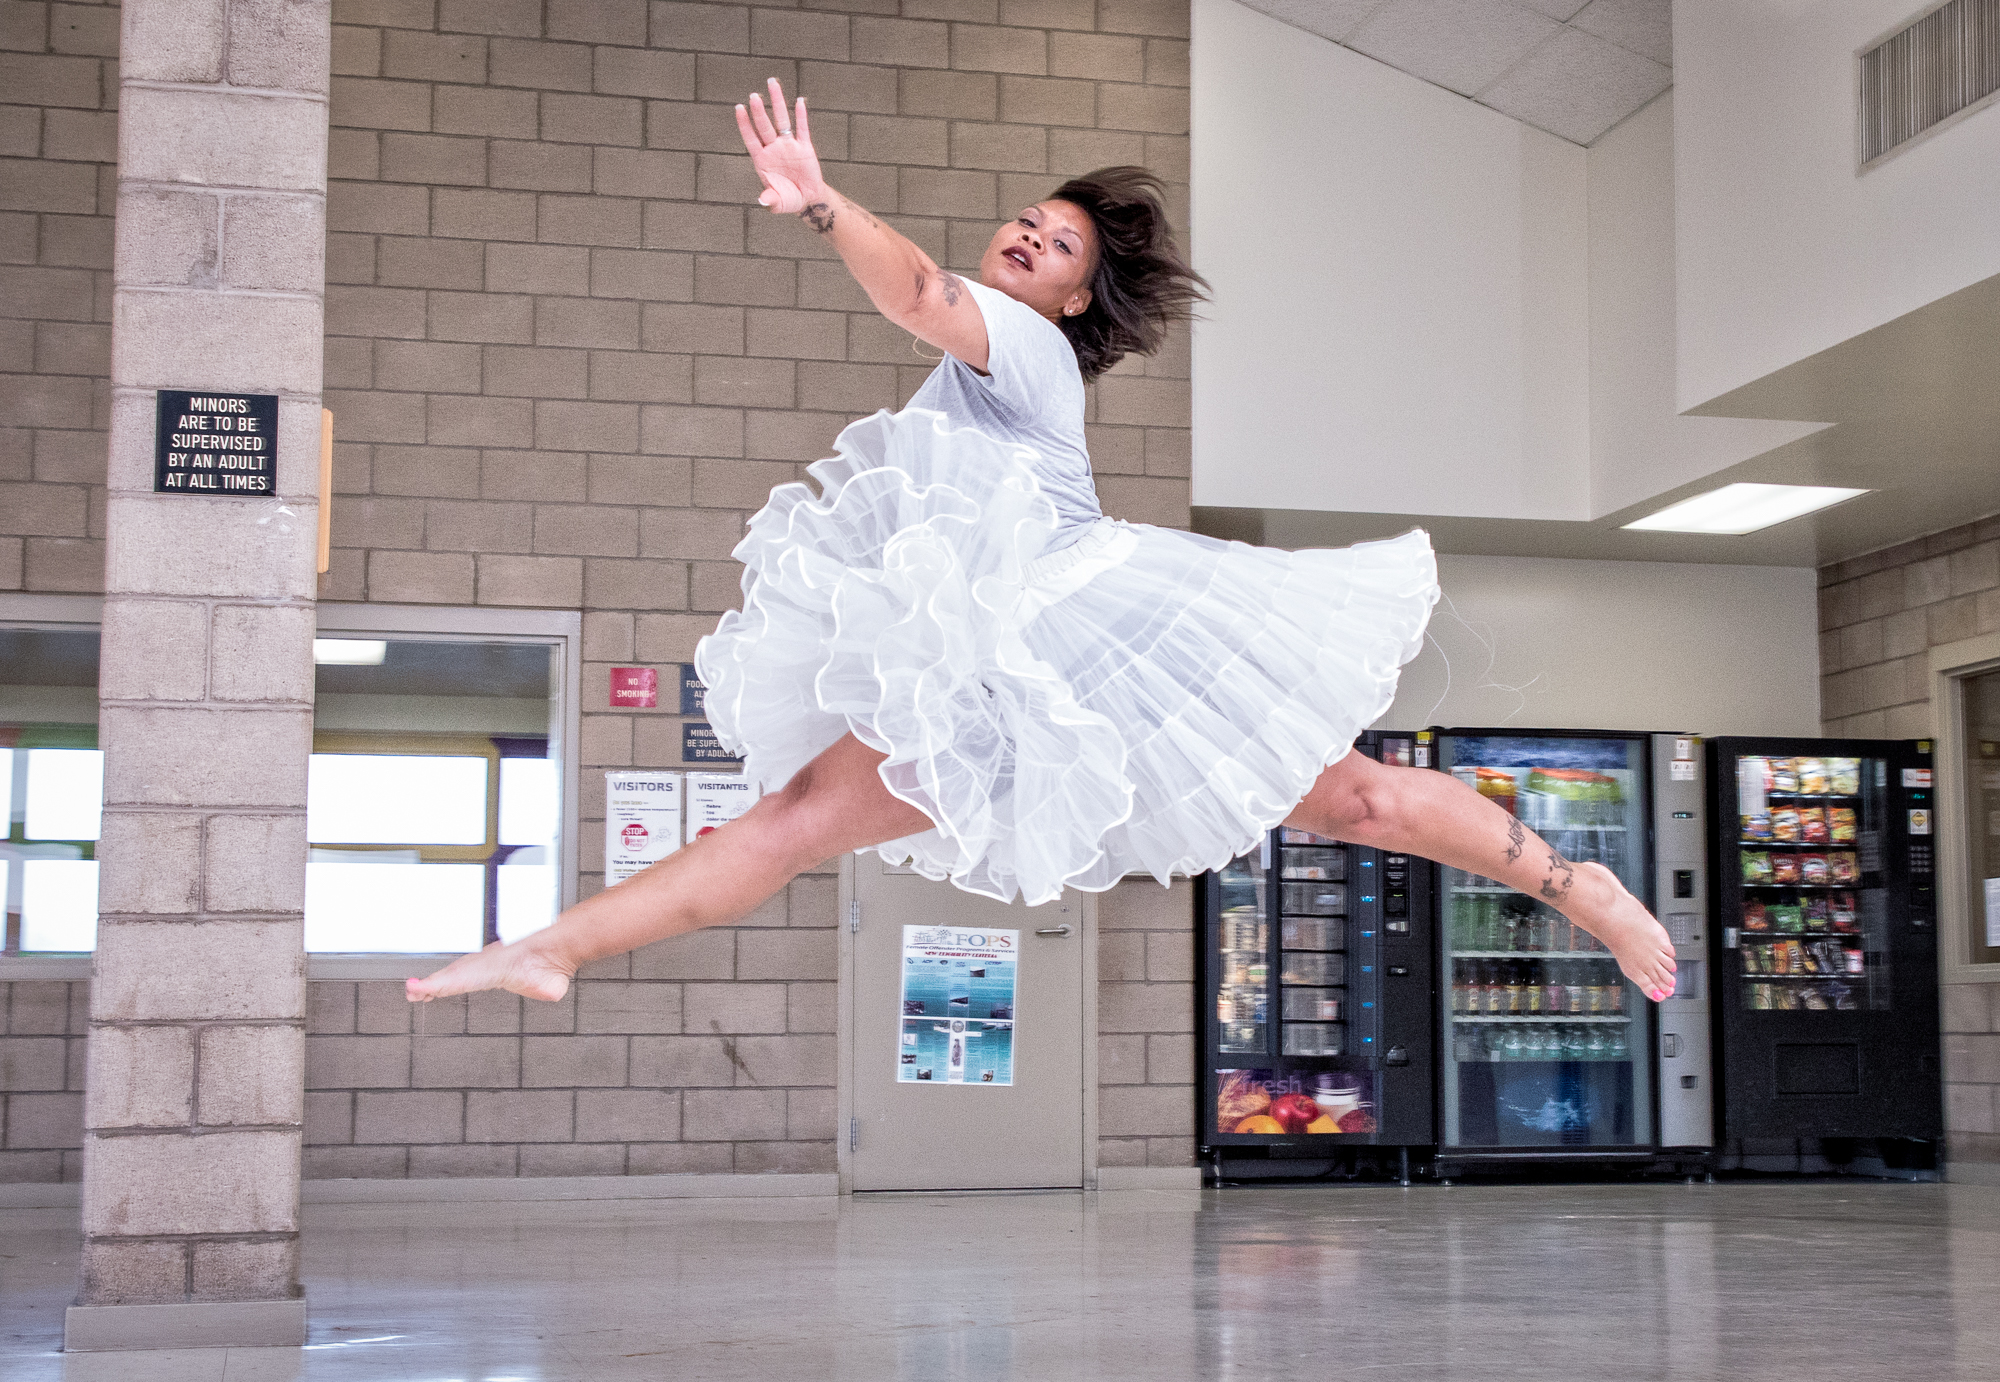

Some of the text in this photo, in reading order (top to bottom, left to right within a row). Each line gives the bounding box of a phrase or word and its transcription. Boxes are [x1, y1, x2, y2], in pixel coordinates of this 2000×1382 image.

[190, 397, 247, 413] MINORS
[178, 415, 257, 432] ARE TO BE
[171, 433, 263, 451] SUPERVISED
[168, 452, 265, 471] BY AN ADULT
[165, 473, 266, 491] AT ALL TIMES
[627, 677, 639, 686] NO
[616, 689, 650, 698] SMOKING
[690, 729, 716, 737] MINOR
[687, 739, 697, 748] BE
[695, 749, 705, 758] BY
[613, 781, 673, 792] VISITORS
[697, 783, 749, 791] VISITANTES
[625, 827, 645, 836] STOP
[955, 933, 1011, 948] FOPS
[1241, 1074, 1302, 1095] fresh
